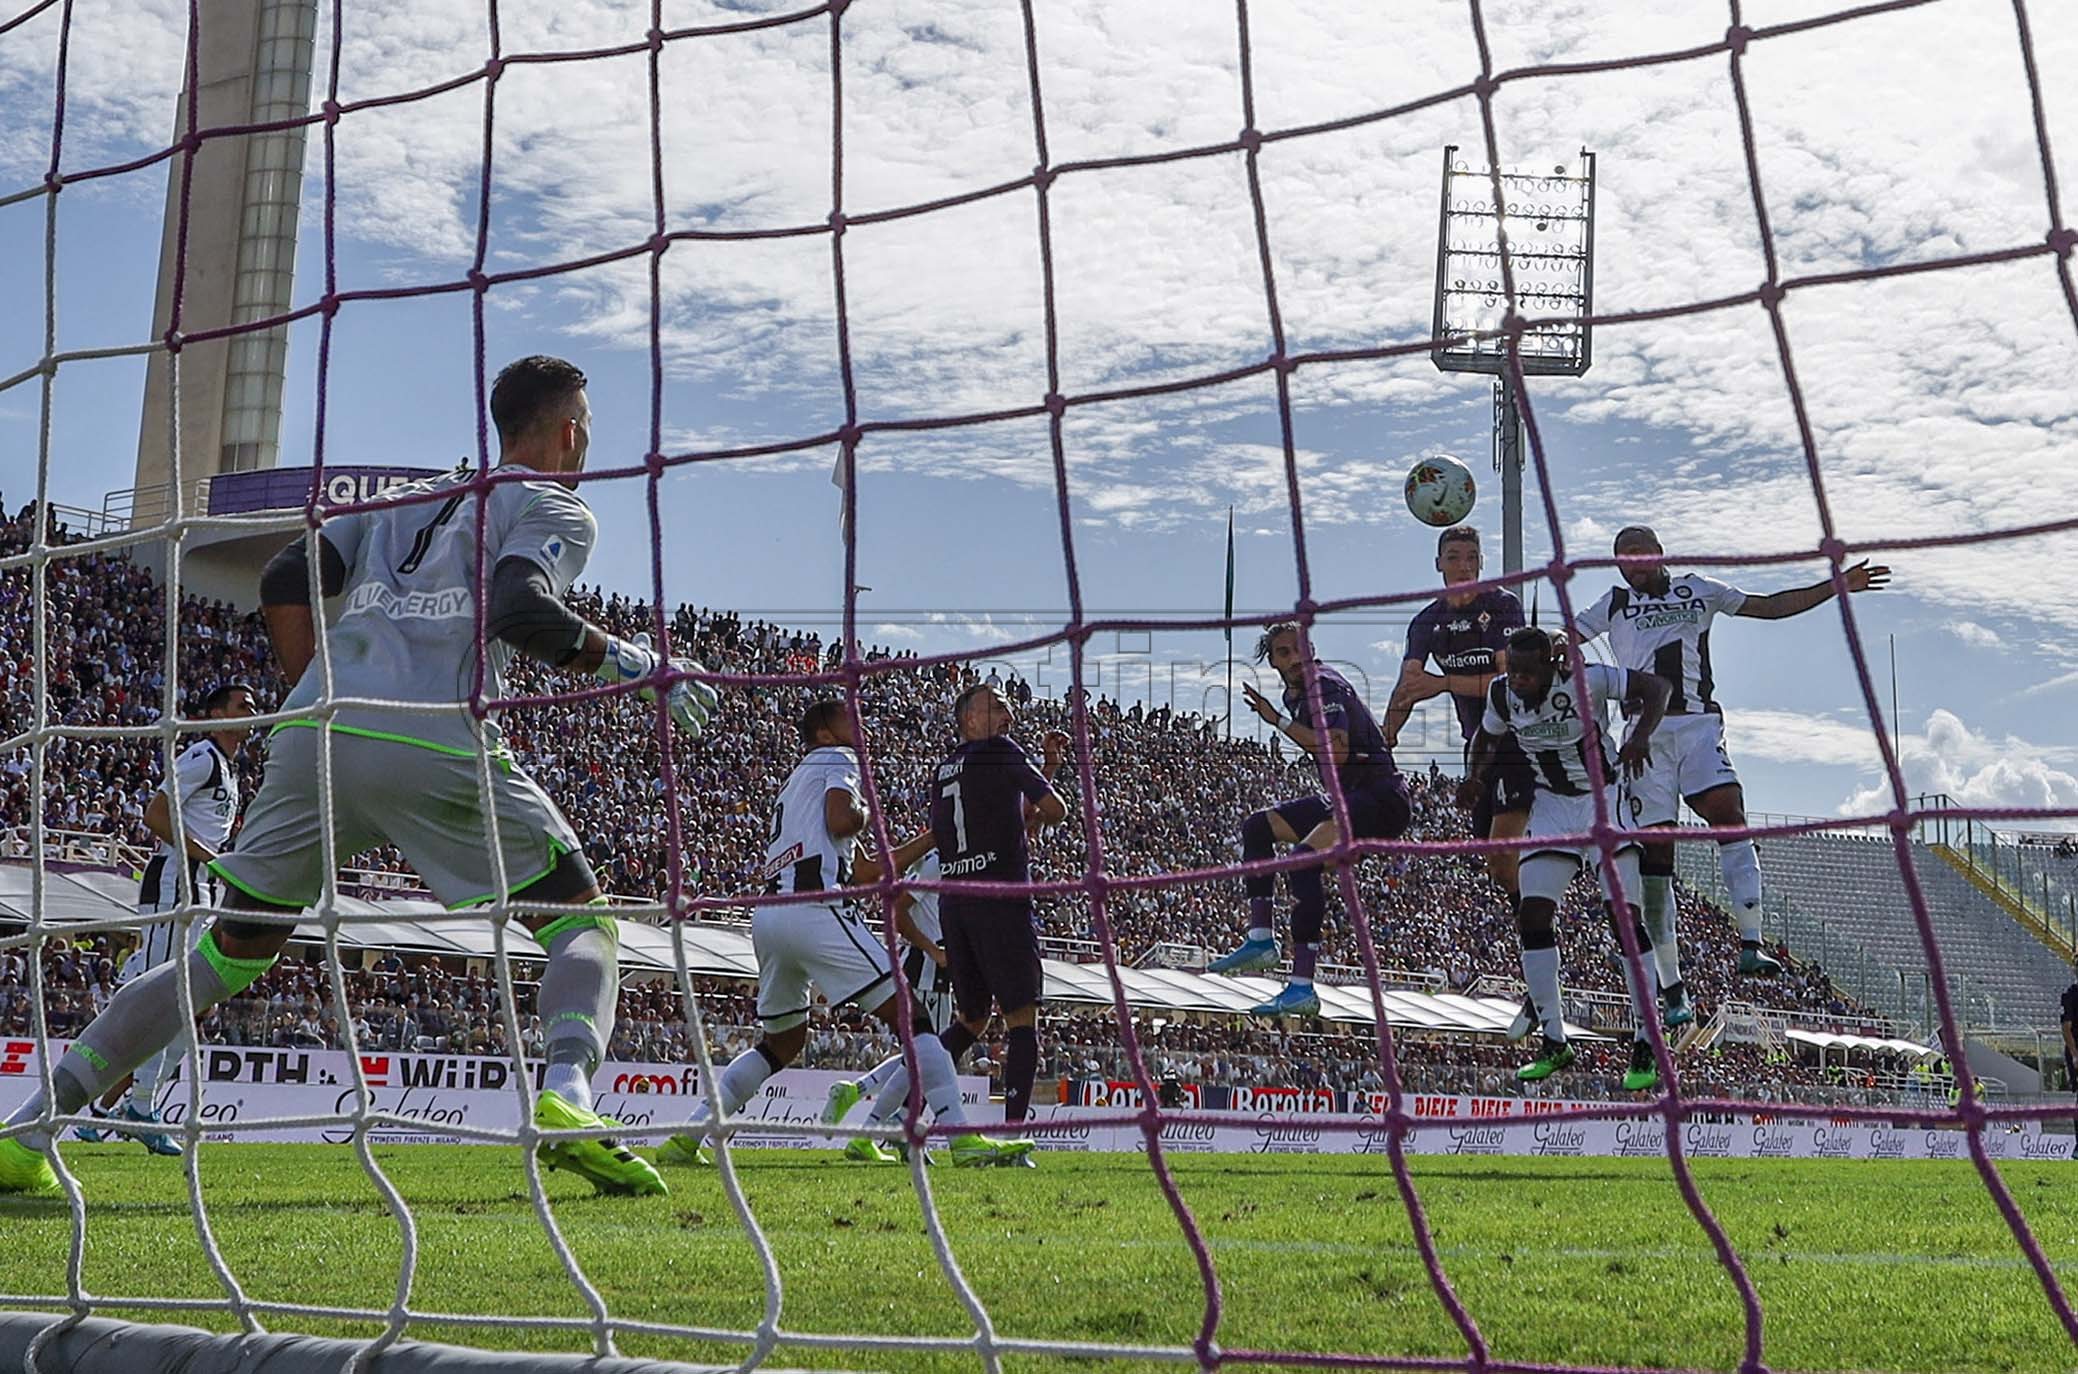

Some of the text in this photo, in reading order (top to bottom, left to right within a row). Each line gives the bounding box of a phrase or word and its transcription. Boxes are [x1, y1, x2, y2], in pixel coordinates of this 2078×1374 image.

[1531, 1120, 1585, 1155] Galateo
[1613, 1122, 1662, 1156] Galateo
[2020, 1133, 2066, 1157] Galateo
